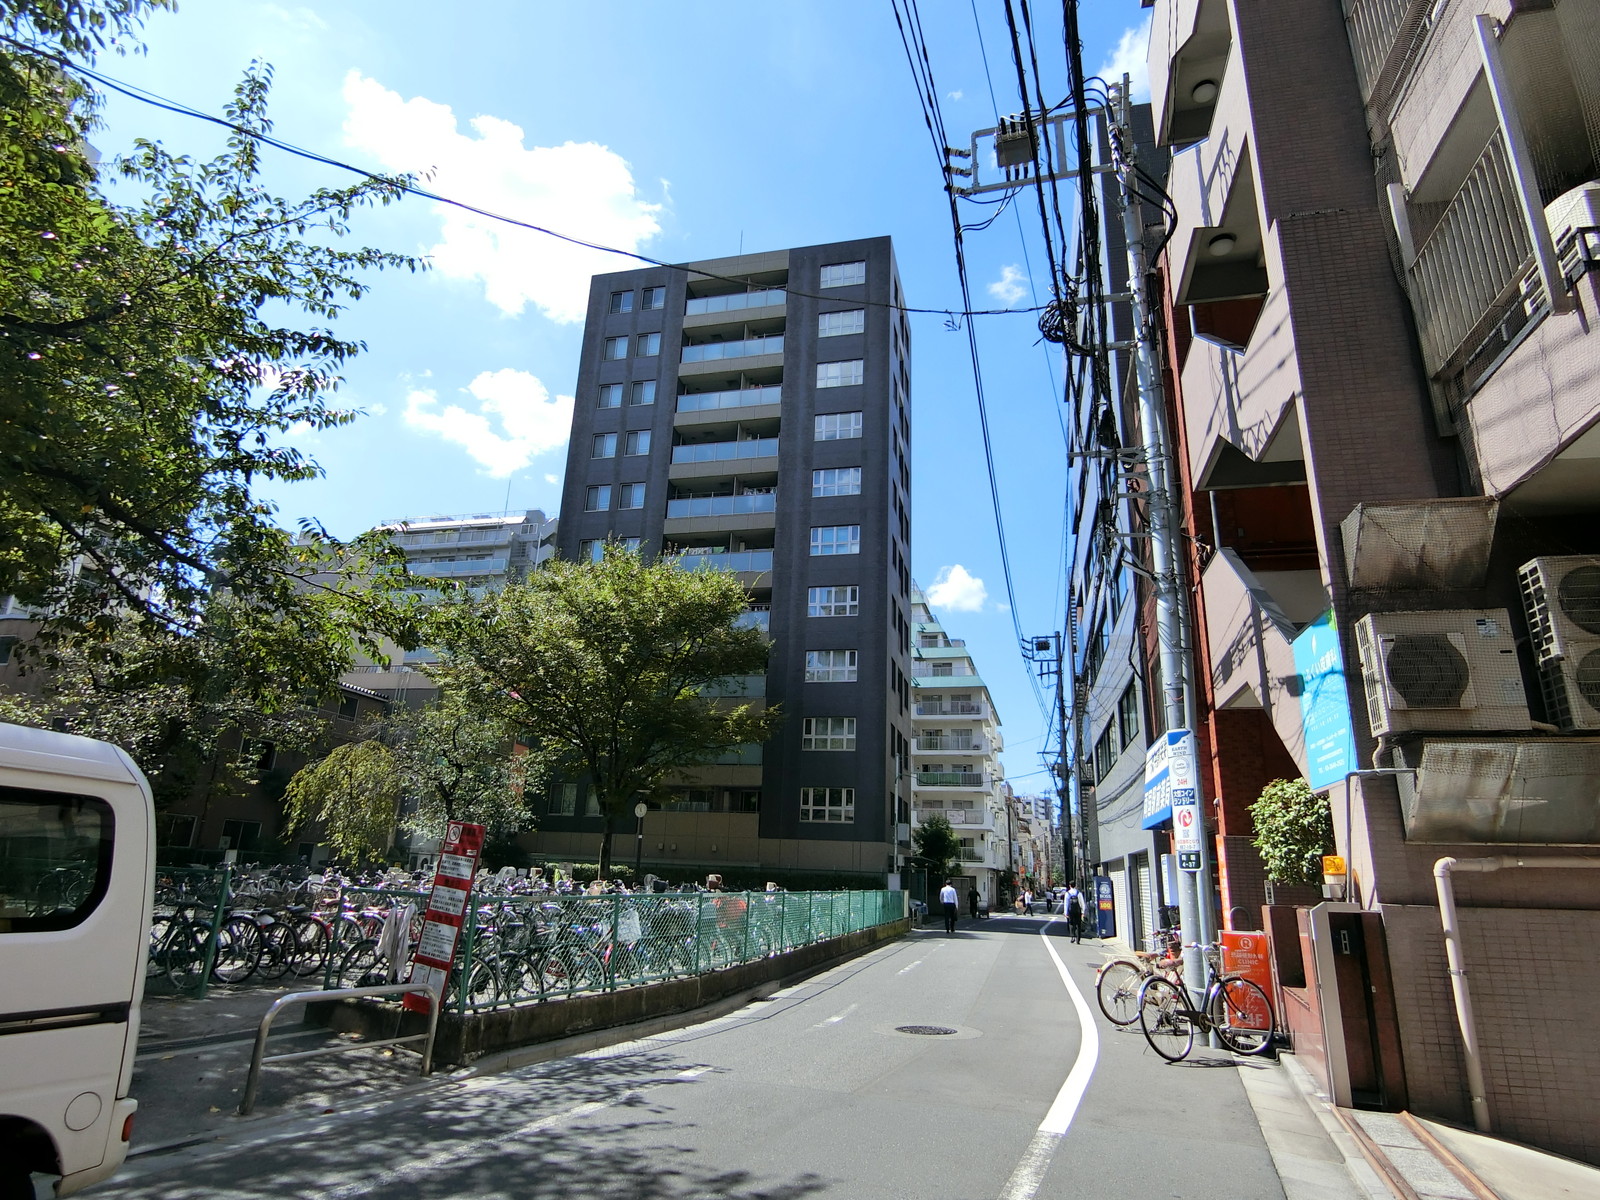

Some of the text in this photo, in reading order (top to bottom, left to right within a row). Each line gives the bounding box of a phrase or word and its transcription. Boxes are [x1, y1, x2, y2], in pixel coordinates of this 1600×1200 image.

[1174, 797, 1195, 805] ランドリー
